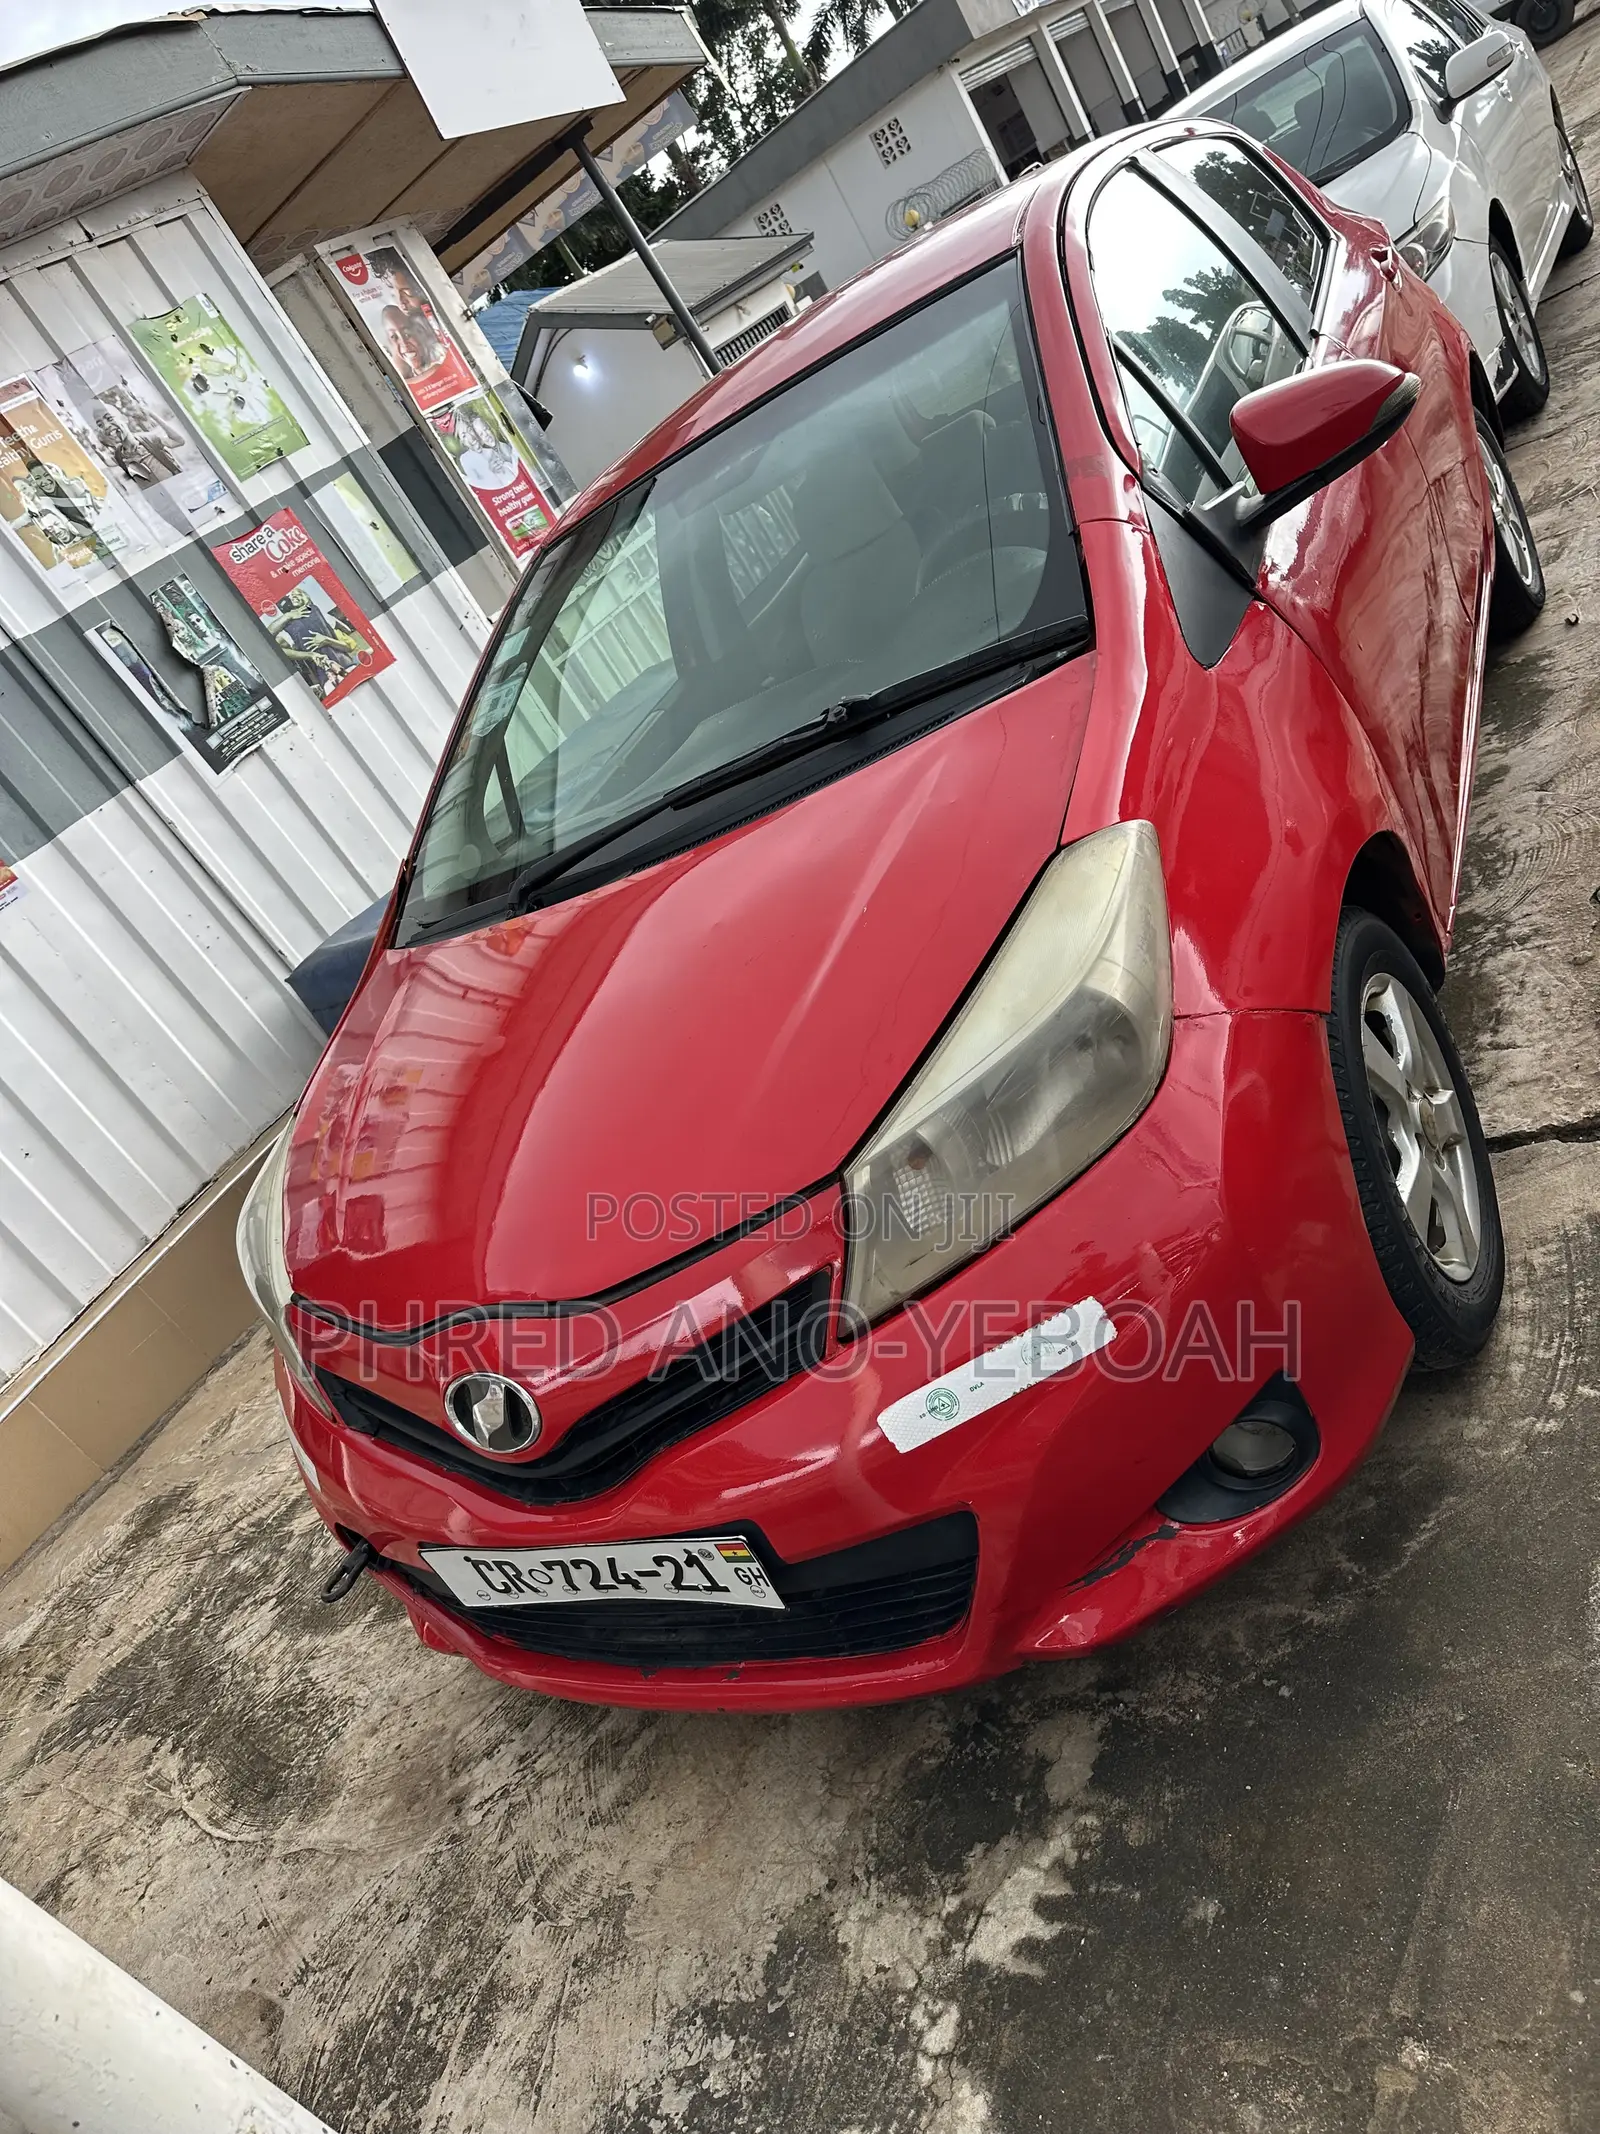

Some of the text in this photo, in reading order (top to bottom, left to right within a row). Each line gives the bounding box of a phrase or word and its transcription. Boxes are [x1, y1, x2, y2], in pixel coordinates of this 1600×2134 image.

[342, 261, 363, 274] Colgate
[0, 445, 32, 468] ealthy
[492, 489, 514, 506] Strong
[497, 496, 523, 517] healthy
[231, 527, 275, 563] share a
[265, 526, 308, 562] Coke
[270, 570, 278, 579] &
[277, 558, 296, 577] make
[969, 1382, 984, 1393] DVLA
[470, 1558, 541, 1594] CR
[539, 1553, 731, 1594] 724-21
[733, 1566, 770, 1587] GH
